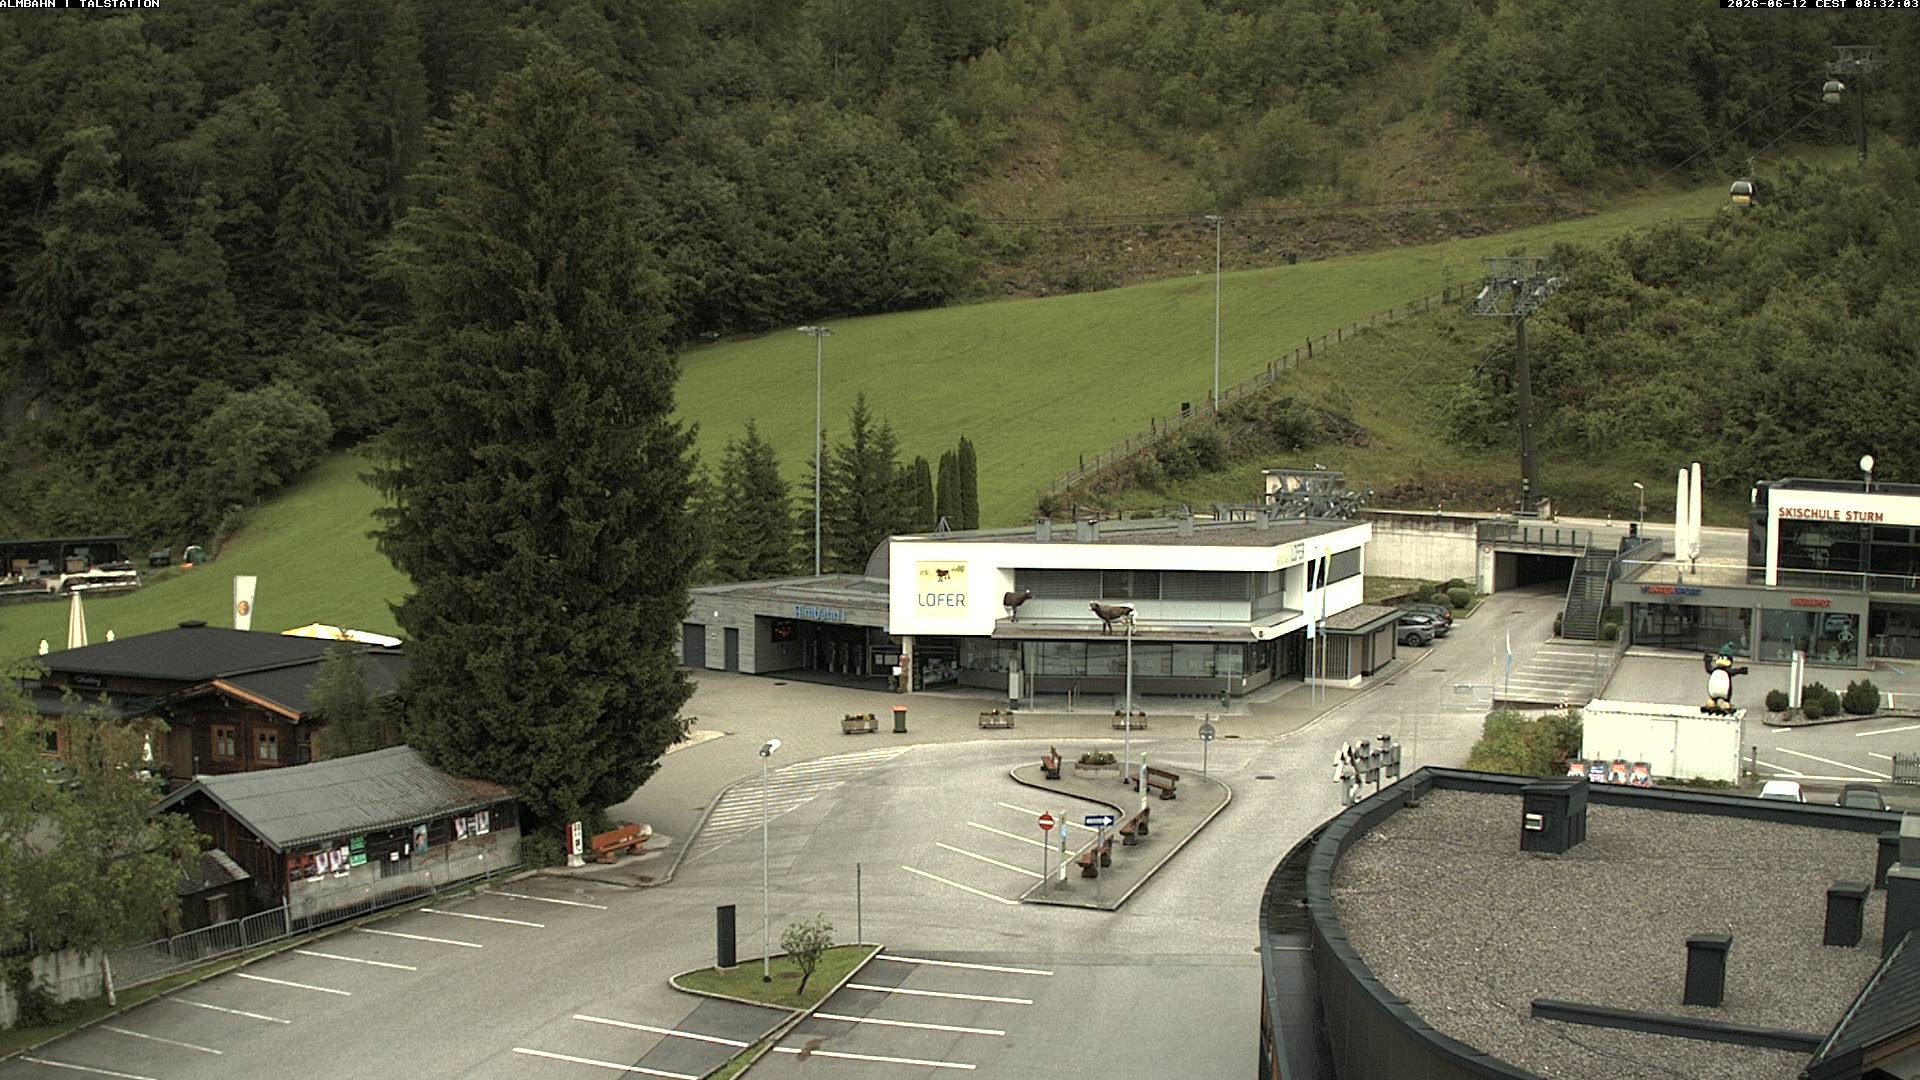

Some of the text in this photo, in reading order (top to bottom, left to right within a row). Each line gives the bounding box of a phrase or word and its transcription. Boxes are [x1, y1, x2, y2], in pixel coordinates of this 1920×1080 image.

[1778, 507, 1884, 522] SKISCHULE STURM
[918, 593, 966, 607] LOFER
